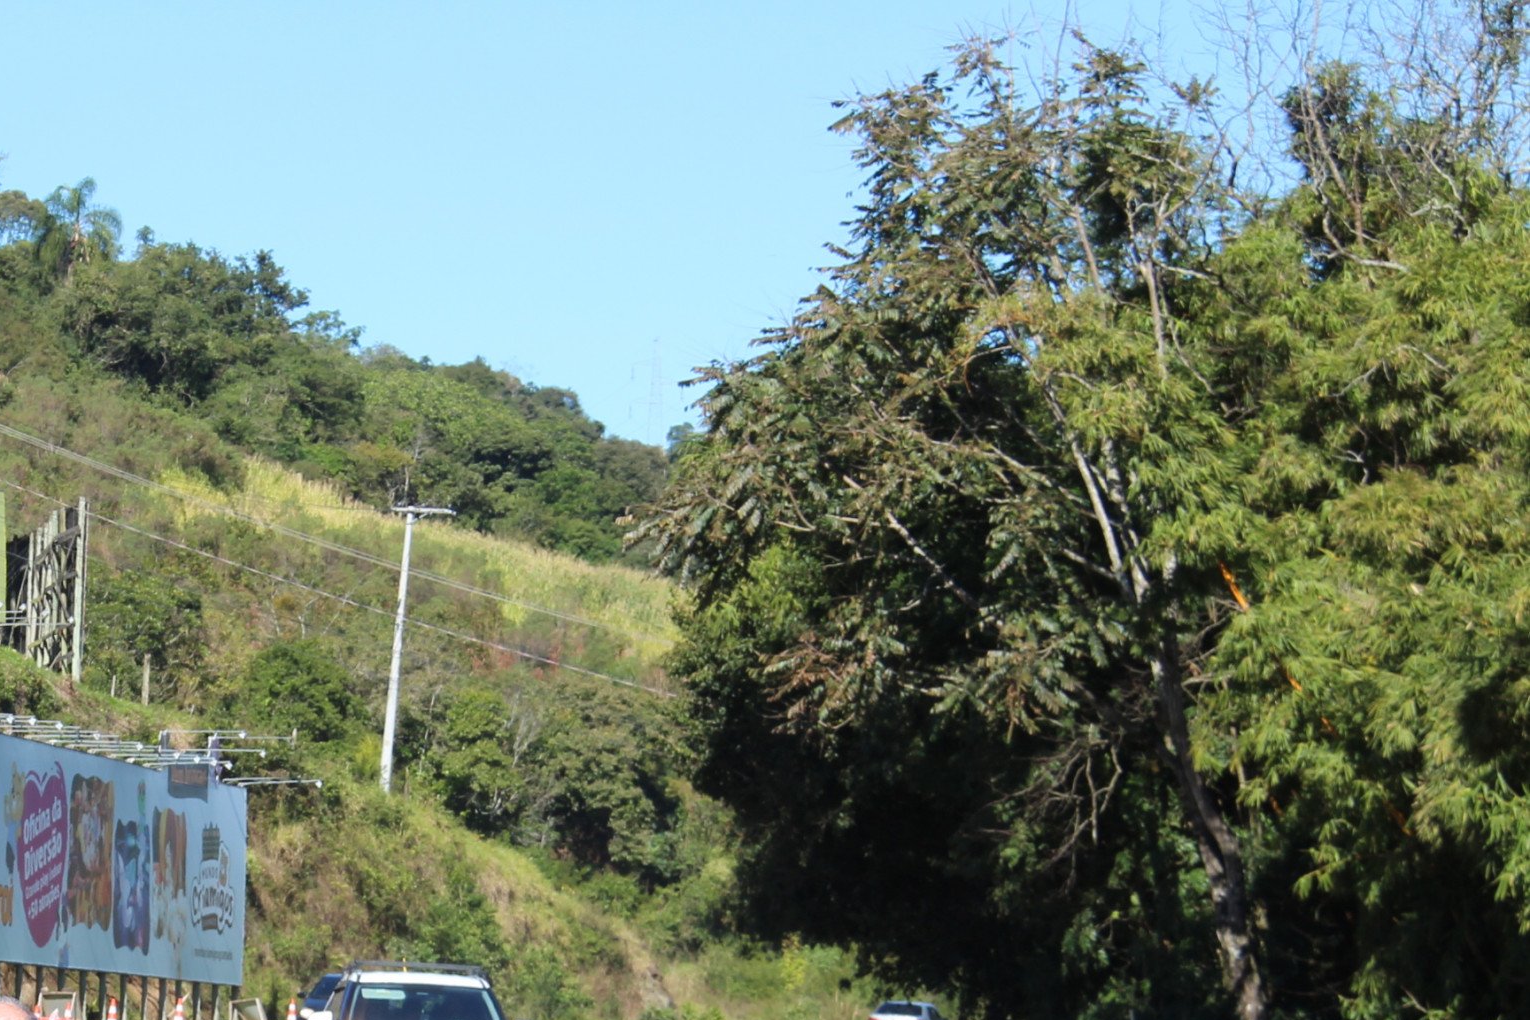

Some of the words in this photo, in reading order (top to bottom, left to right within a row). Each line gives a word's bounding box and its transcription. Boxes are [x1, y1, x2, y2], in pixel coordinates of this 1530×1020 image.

[23, 808, 50, 845] Oficina
[52, 795, 62, 822] da
[24, 827, 62, 881] Diversão
